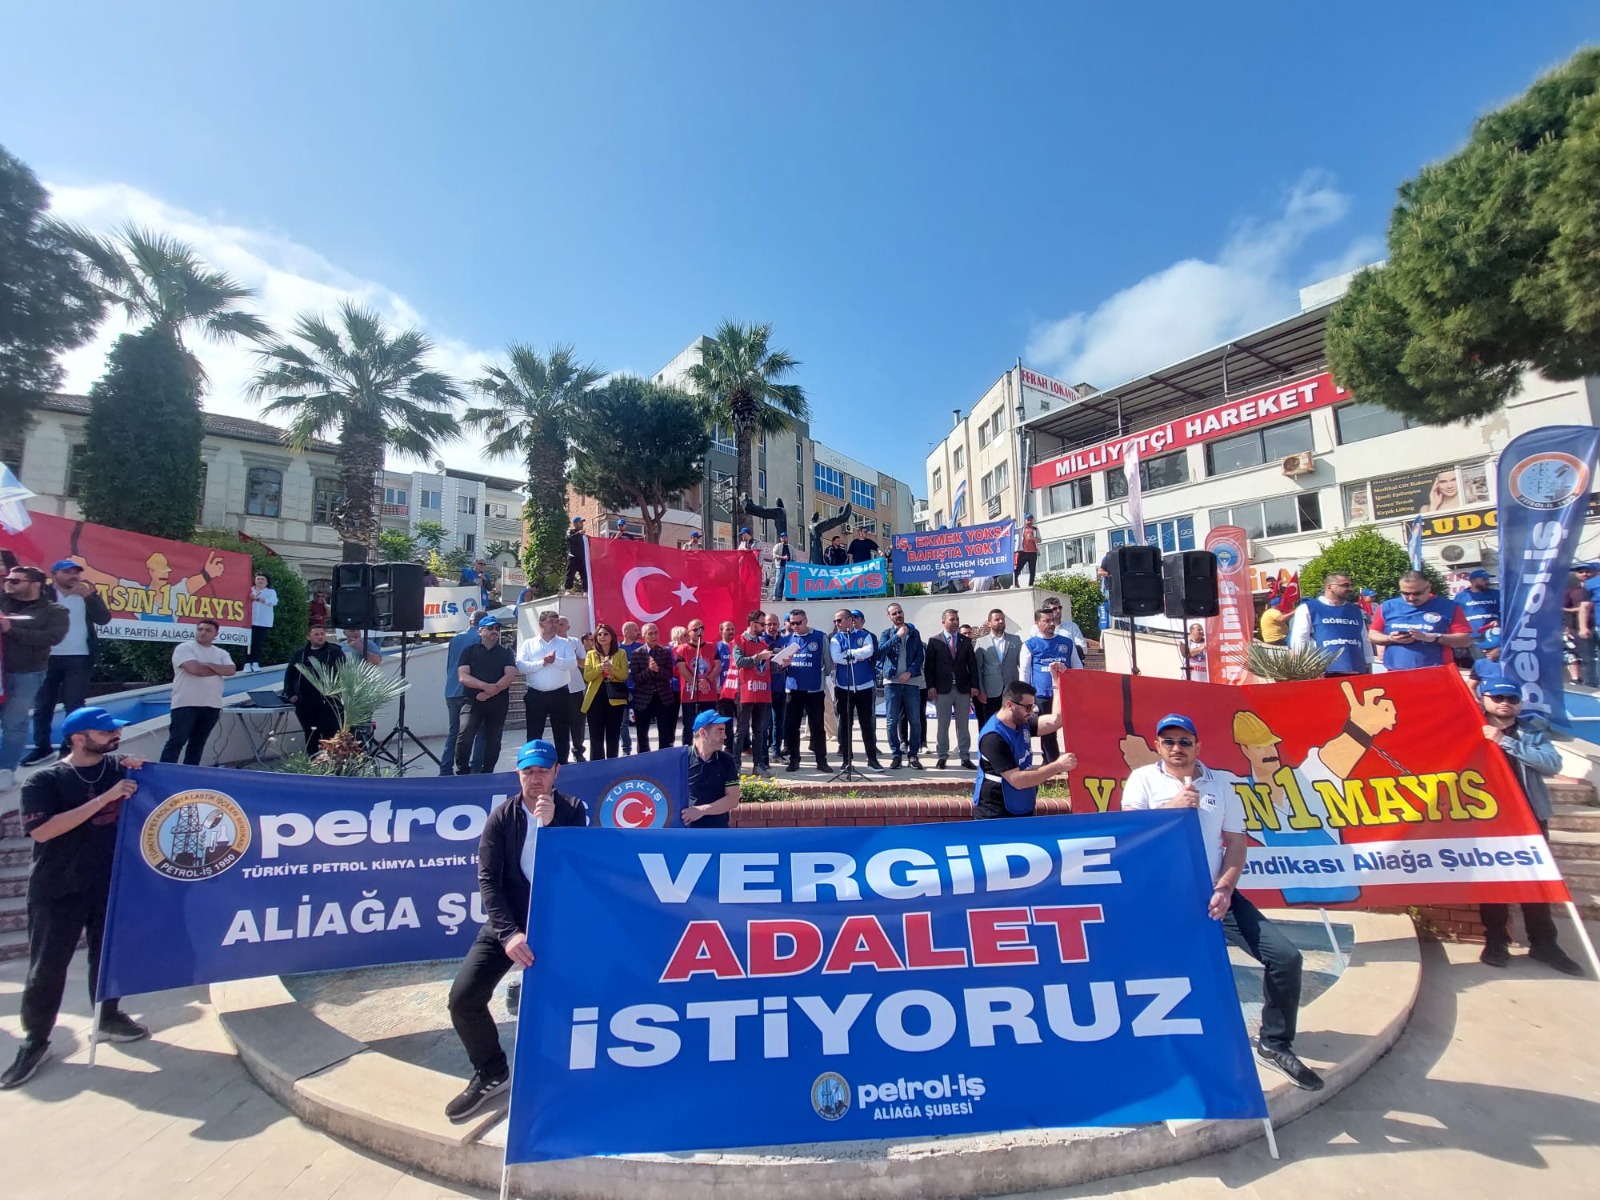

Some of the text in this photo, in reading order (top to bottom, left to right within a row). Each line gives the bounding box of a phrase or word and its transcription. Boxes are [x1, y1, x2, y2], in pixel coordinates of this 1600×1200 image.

[1021, 369, 1048, 390] FERAH
[1186, 382, 1318, 439] HAREKET
[915, 532, 963, 548] EKMEK
[966, 525, 1011, 542] YOKSA
[965, 542, 993, 557] YOK
[935, 560, 976, 571] EASTCHEM
[788, 571, 884, 595] 1 MAYIS
[157, 584, 172, 615] 1
[176, 593, 245, 622] MAYIS
[1511, 520, 1569, 715] petrol-iş
[96, 626, 121, 636] HALK
[124, 627, 158, 638] PARTİSİ
[1272, 765, 1318, 830] 1
[1314, 769, 1500, 829] MAYIS
[160, 853, 236, 878] PETROL-İŞ 1950
[242, 863, 308, 879] TÜRKİYE
[312, 861, 368, 874] PETROL
[372, 858, 415, 870] KİMYA
[419, 855, 467, 868] LASTİK
[1241, 845, 1545, 876] endikası Aliağa Şubesi
[221, 889, 421, 947] ALİAĞA
[657, 903, 1105, 984] ADALET
[857, 1073, 986, 1109] petrol-iş
[873, 1098, 974, 1121] ALİAĞA ŞUBESİ
